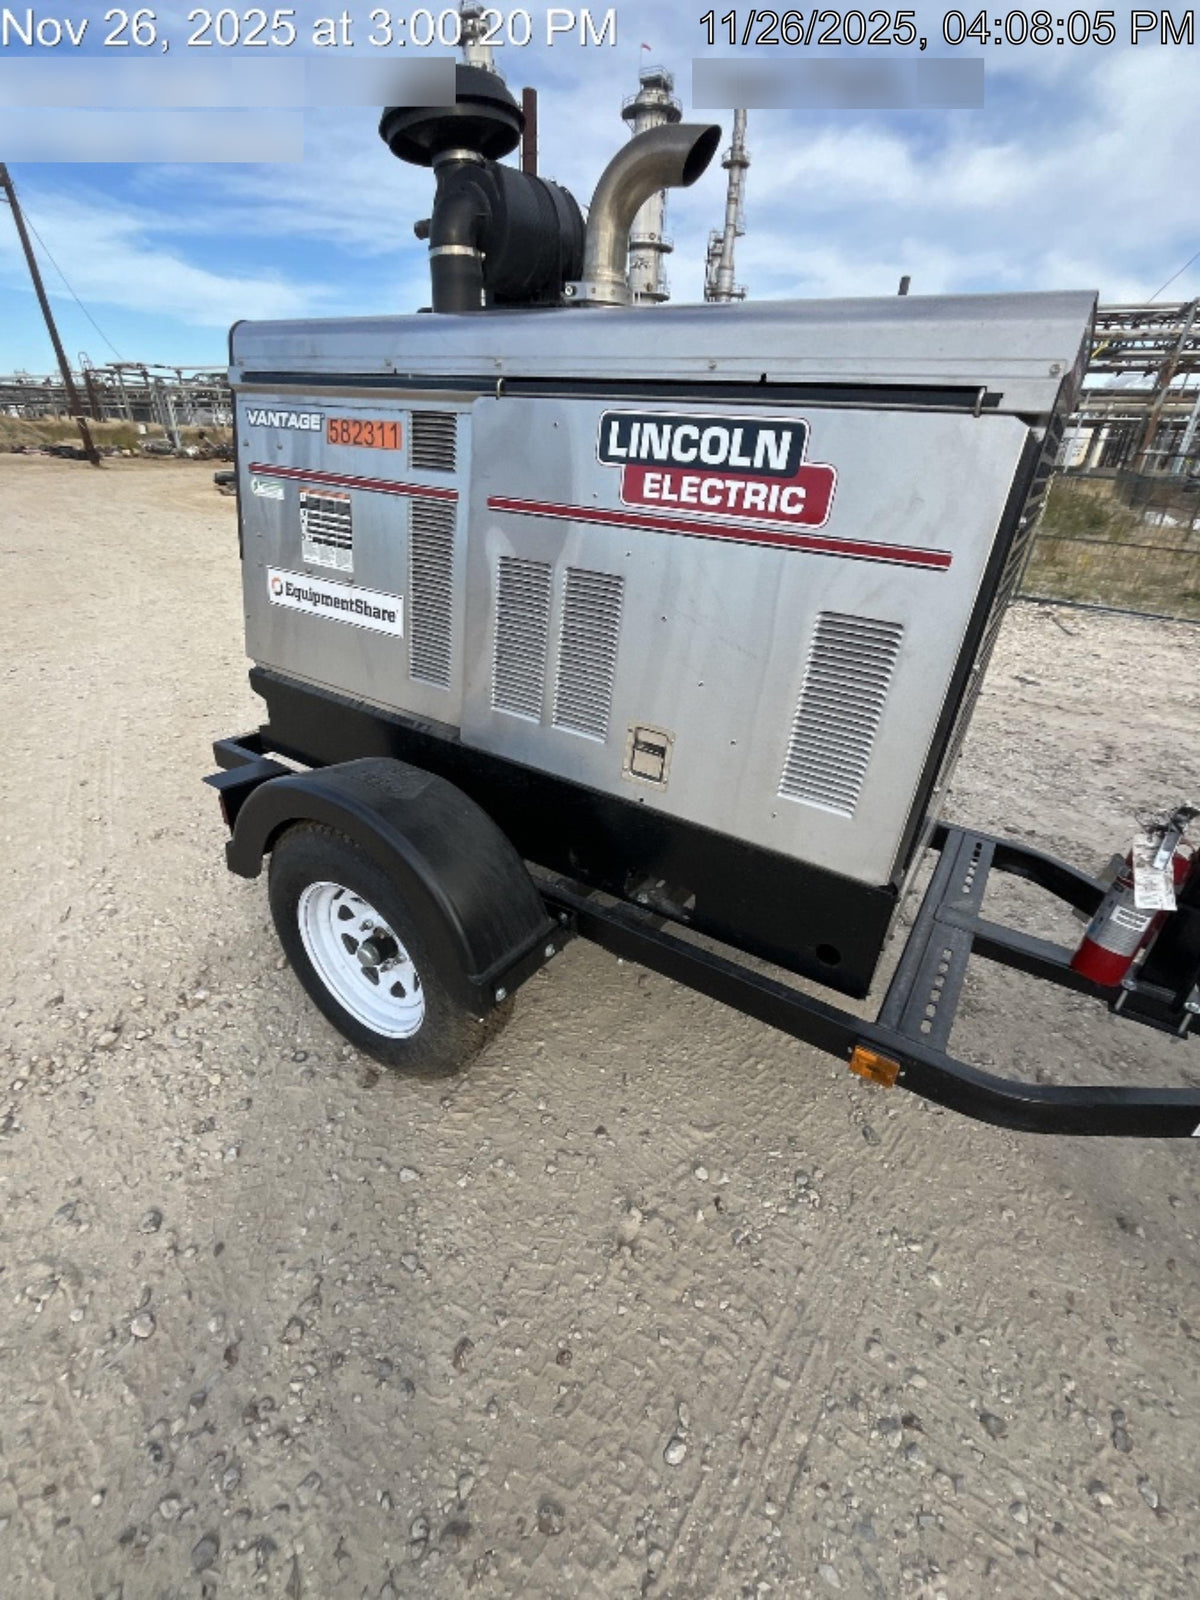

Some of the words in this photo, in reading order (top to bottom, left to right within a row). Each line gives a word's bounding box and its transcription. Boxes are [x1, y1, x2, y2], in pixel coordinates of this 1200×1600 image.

[246, 409, 322, 431] VANTAGE
[329, 419, 399, 449] 582311
[607, 420, 793, 471] LINCOLN
[642, 472, 807, 516] ELECTRIC
[285, 581, 398, 623] EquipmentShare
